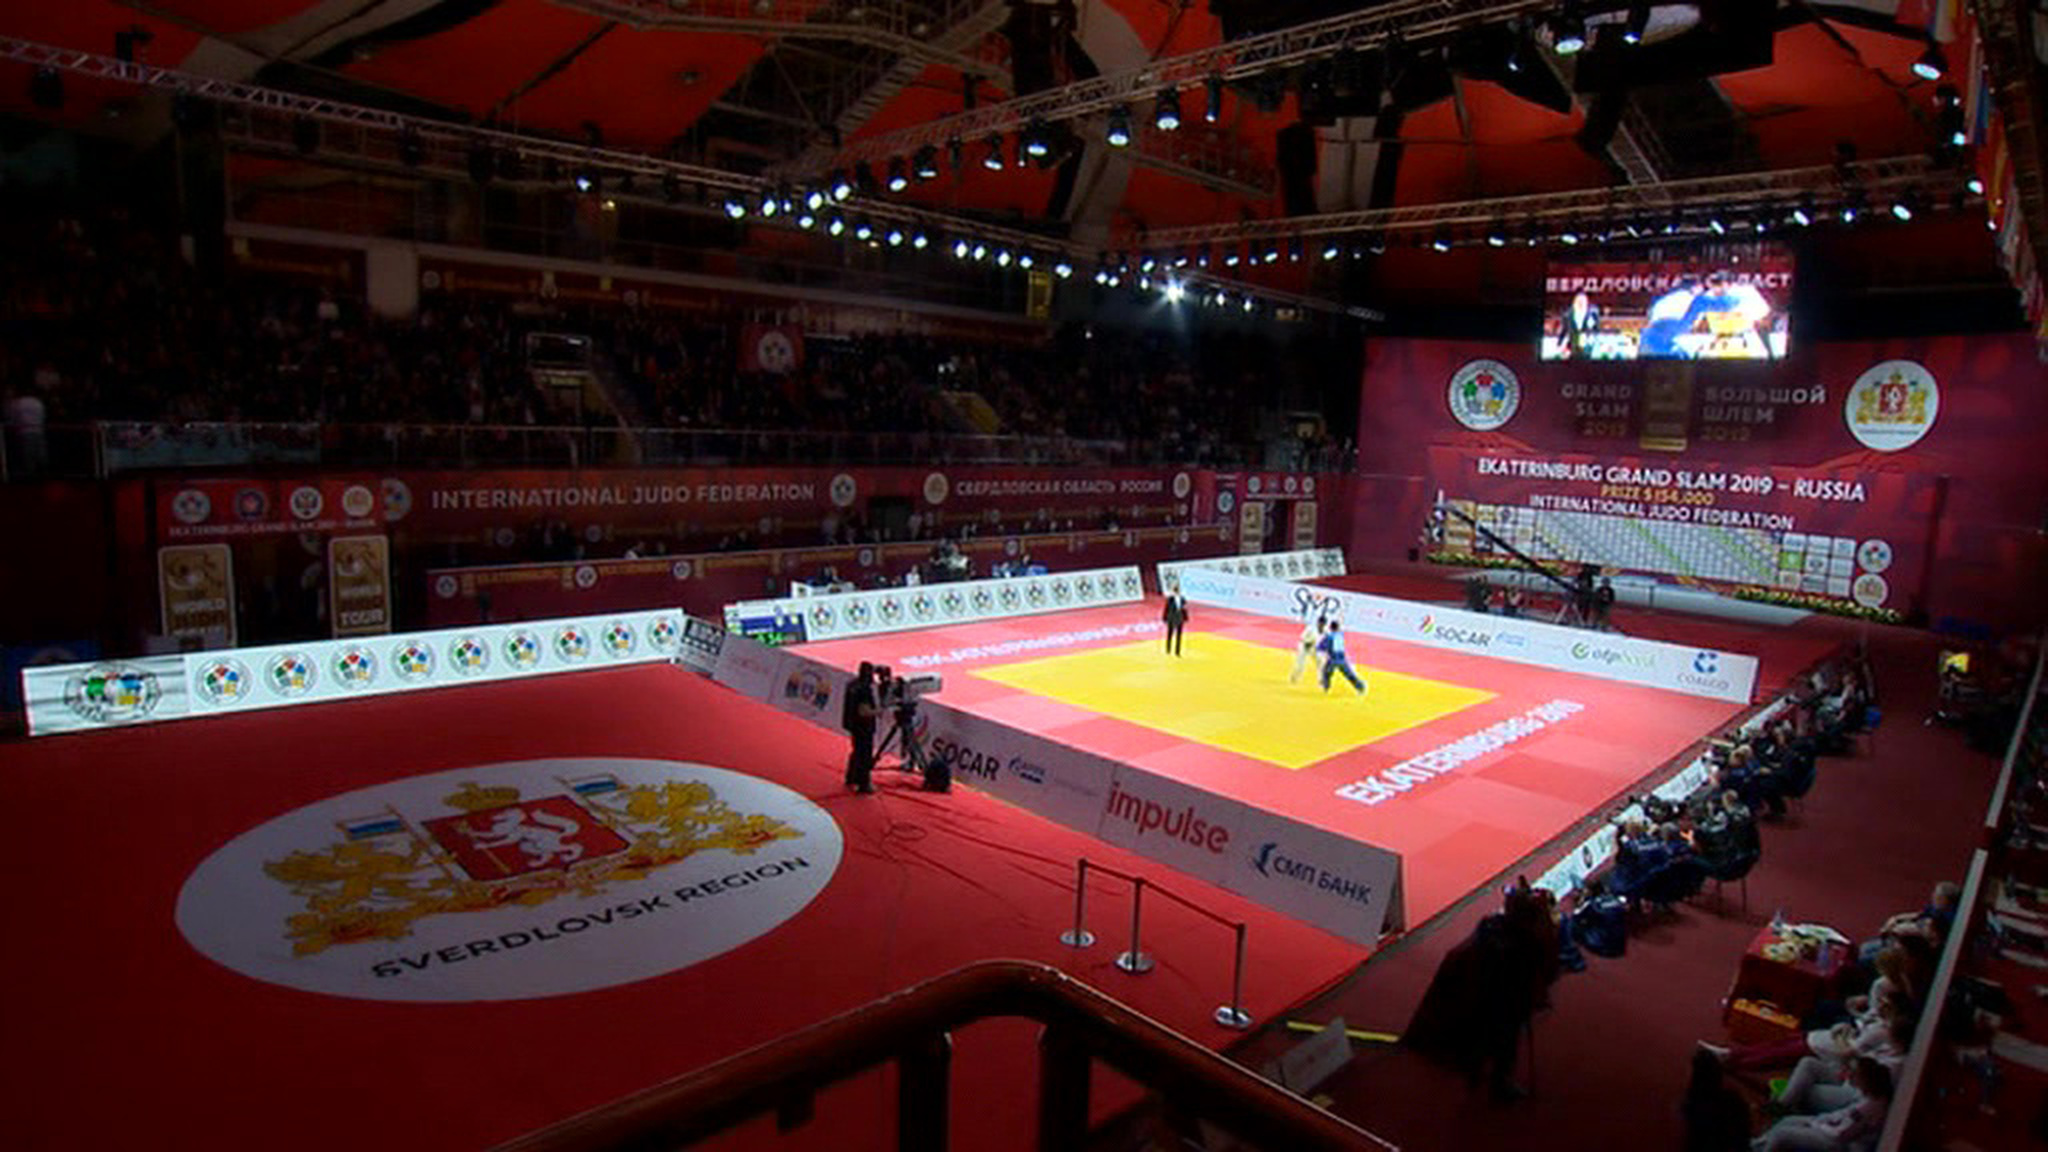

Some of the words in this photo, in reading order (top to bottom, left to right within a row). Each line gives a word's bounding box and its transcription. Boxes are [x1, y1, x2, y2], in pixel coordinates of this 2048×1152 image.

[1561, 383, 1632, 399] GRAND
[1705, 384, 1826, 405] БОЛЬШОЙ
[1575, 401, 1630, 417] SLAM
[1703, 405, 1775, 424] ШЛЕМ
[955, 478, 1062, 498] СВЕРДЛОВСКАЯ
[1062, 478, 1116, 495] ОБЛАСТЬ
[1120, 477, 1164, 494] РОССИЯ
[1478, 457, 1602, 482] EKATERINBURG
[1606, 465, 1671, 488] GRAND
[1675, 469, 1726, 491] SLAM
[1731, 473, 1772, 495] 2019
[1793, 478, 1865, 503] RUSSIA
[1600, 483, 1640, 499] PRIZE
[432, 486, 626, 510] INTERNATIONAL
[631, 485, 691, 505] JUDO
[696, 482, 816, 504] FEDERATION
[1529, 494, 1644, 518] INTERNATIONAL
[1648, 501, 1690, 521] JUDO
[1693, 506, 1794, 531] FEDERATION
[1435, 624, 1492, 648] SOCAR
[929, 737, 1001, 782] SOCAR
[1106, 781, 1229, 855] impulse
[1273, 855, 1317, 886] СМП
[1317, 871, 1373, 906] БАНК
[370, 894, 668, 980] SVERDLOVSK
[675, 856, 810, 904] REGION
